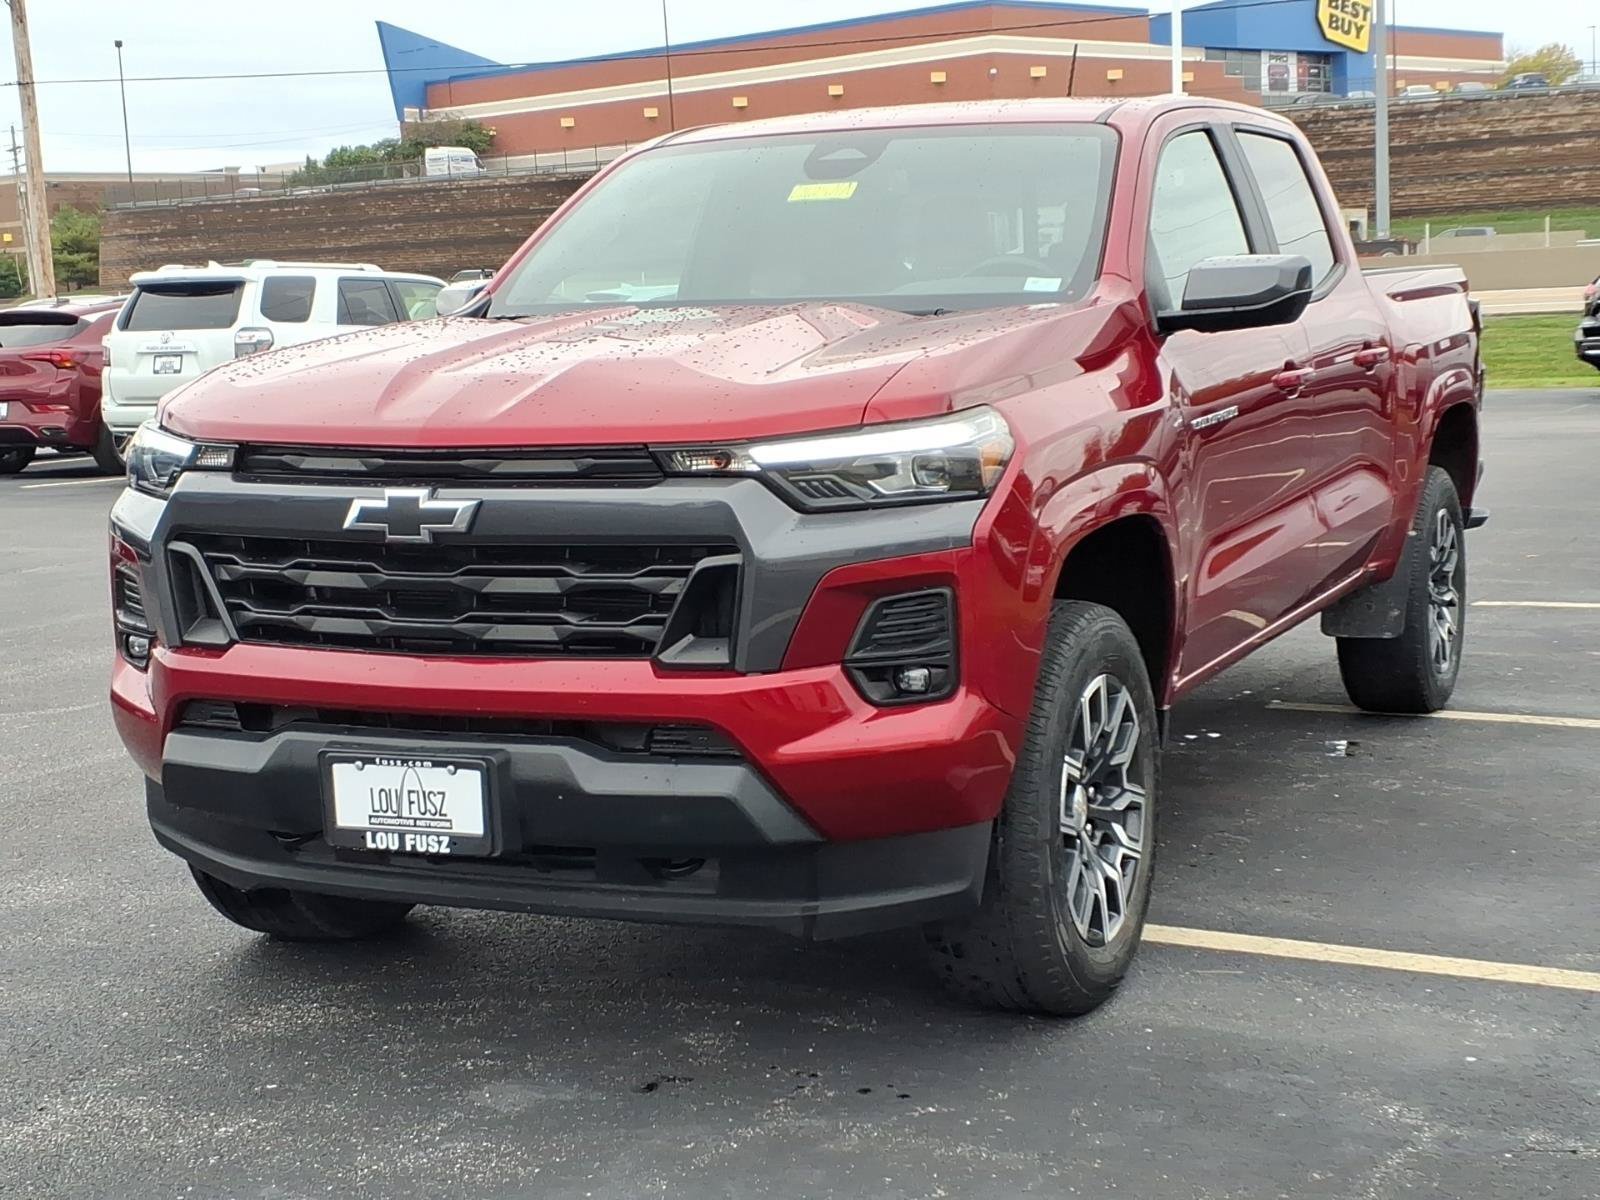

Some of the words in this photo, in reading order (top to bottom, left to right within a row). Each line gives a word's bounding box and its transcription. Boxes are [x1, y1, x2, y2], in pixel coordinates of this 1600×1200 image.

[1328, 0, 1371, 21] BEST
[1328, 13, 1365, 39] BUY
[375, 757, 433, 768] fusz.com
[370, 787, 400, 814] LOU
[407, 790, 447, 817] FUSZ
[370, 816, 415, 826] AUTOMOTIVE
[416, 819, 452, 829] NETWORK
[366, 831, 400, 850] LOU
[405, 833, 451, 854] FUSZ
